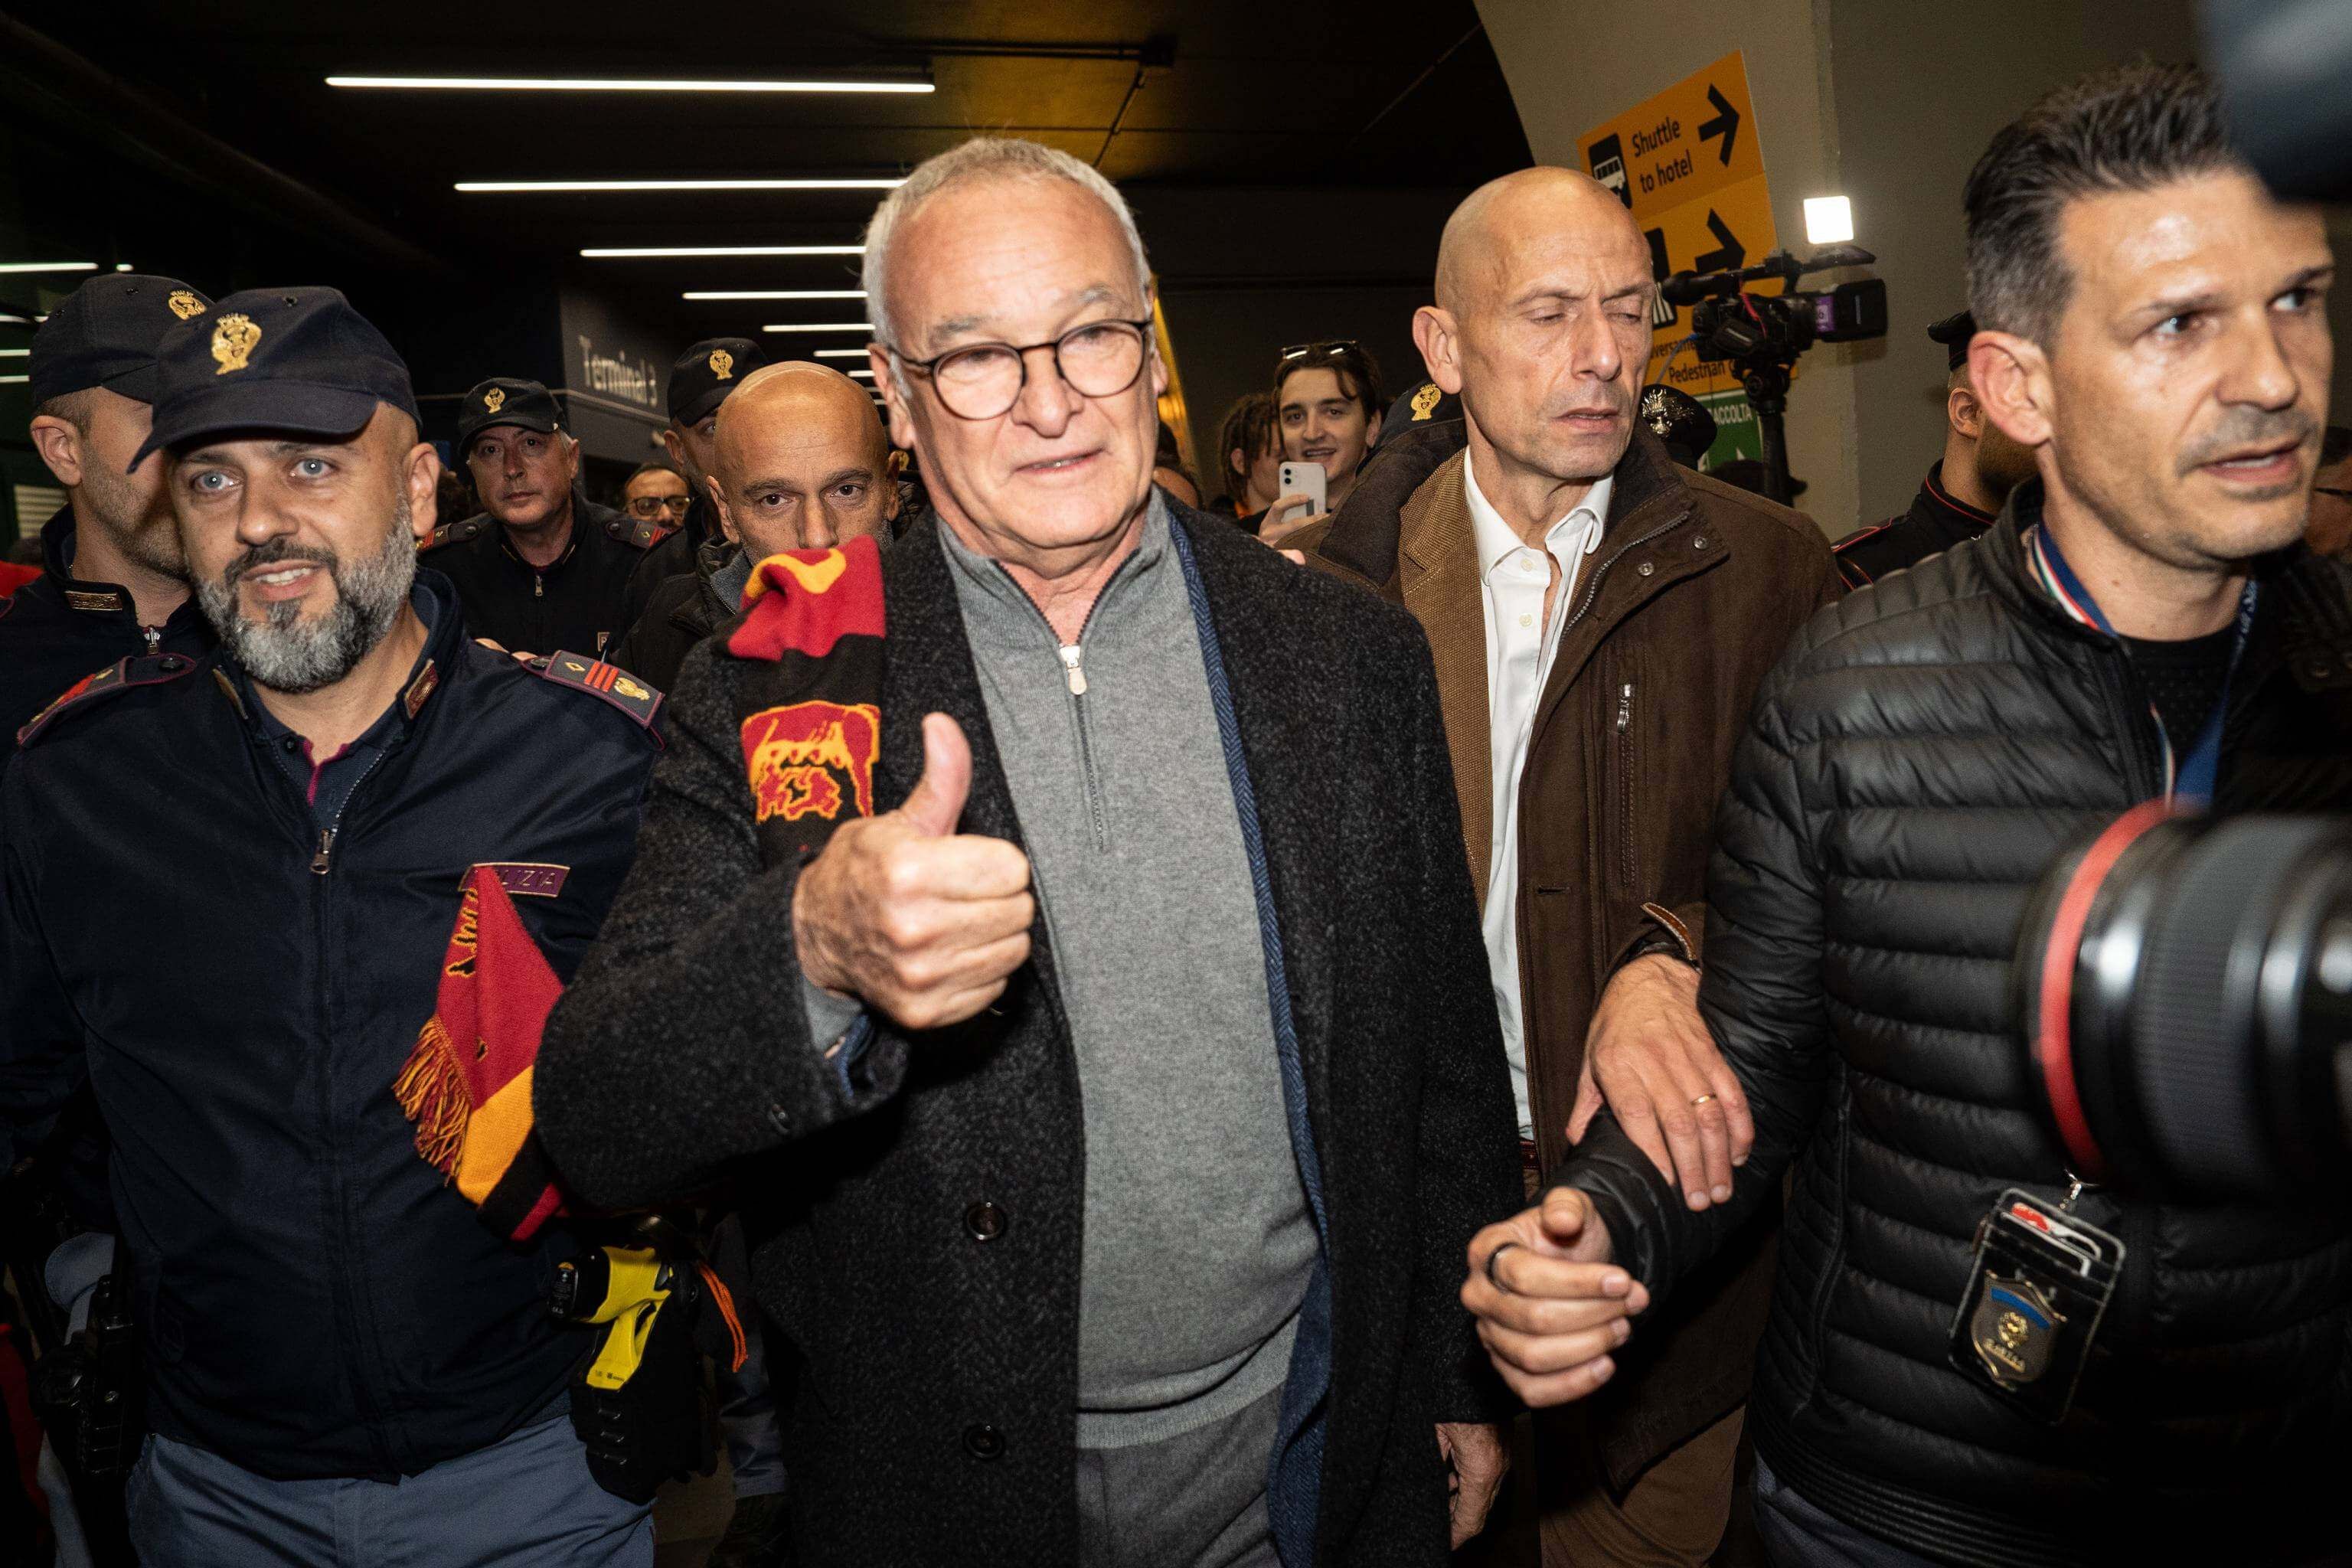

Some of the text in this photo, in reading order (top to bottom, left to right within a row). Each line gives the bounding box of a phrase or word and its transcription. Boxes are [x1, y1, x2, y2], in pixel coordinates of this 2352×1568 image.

[1632, 116, 1681, 158] Shuttle
[1640, 149, 1694, 194] to hotel
[579, 335, 648, 405] Terminal
[1669, 361, 1726, 383] Pedestrian
